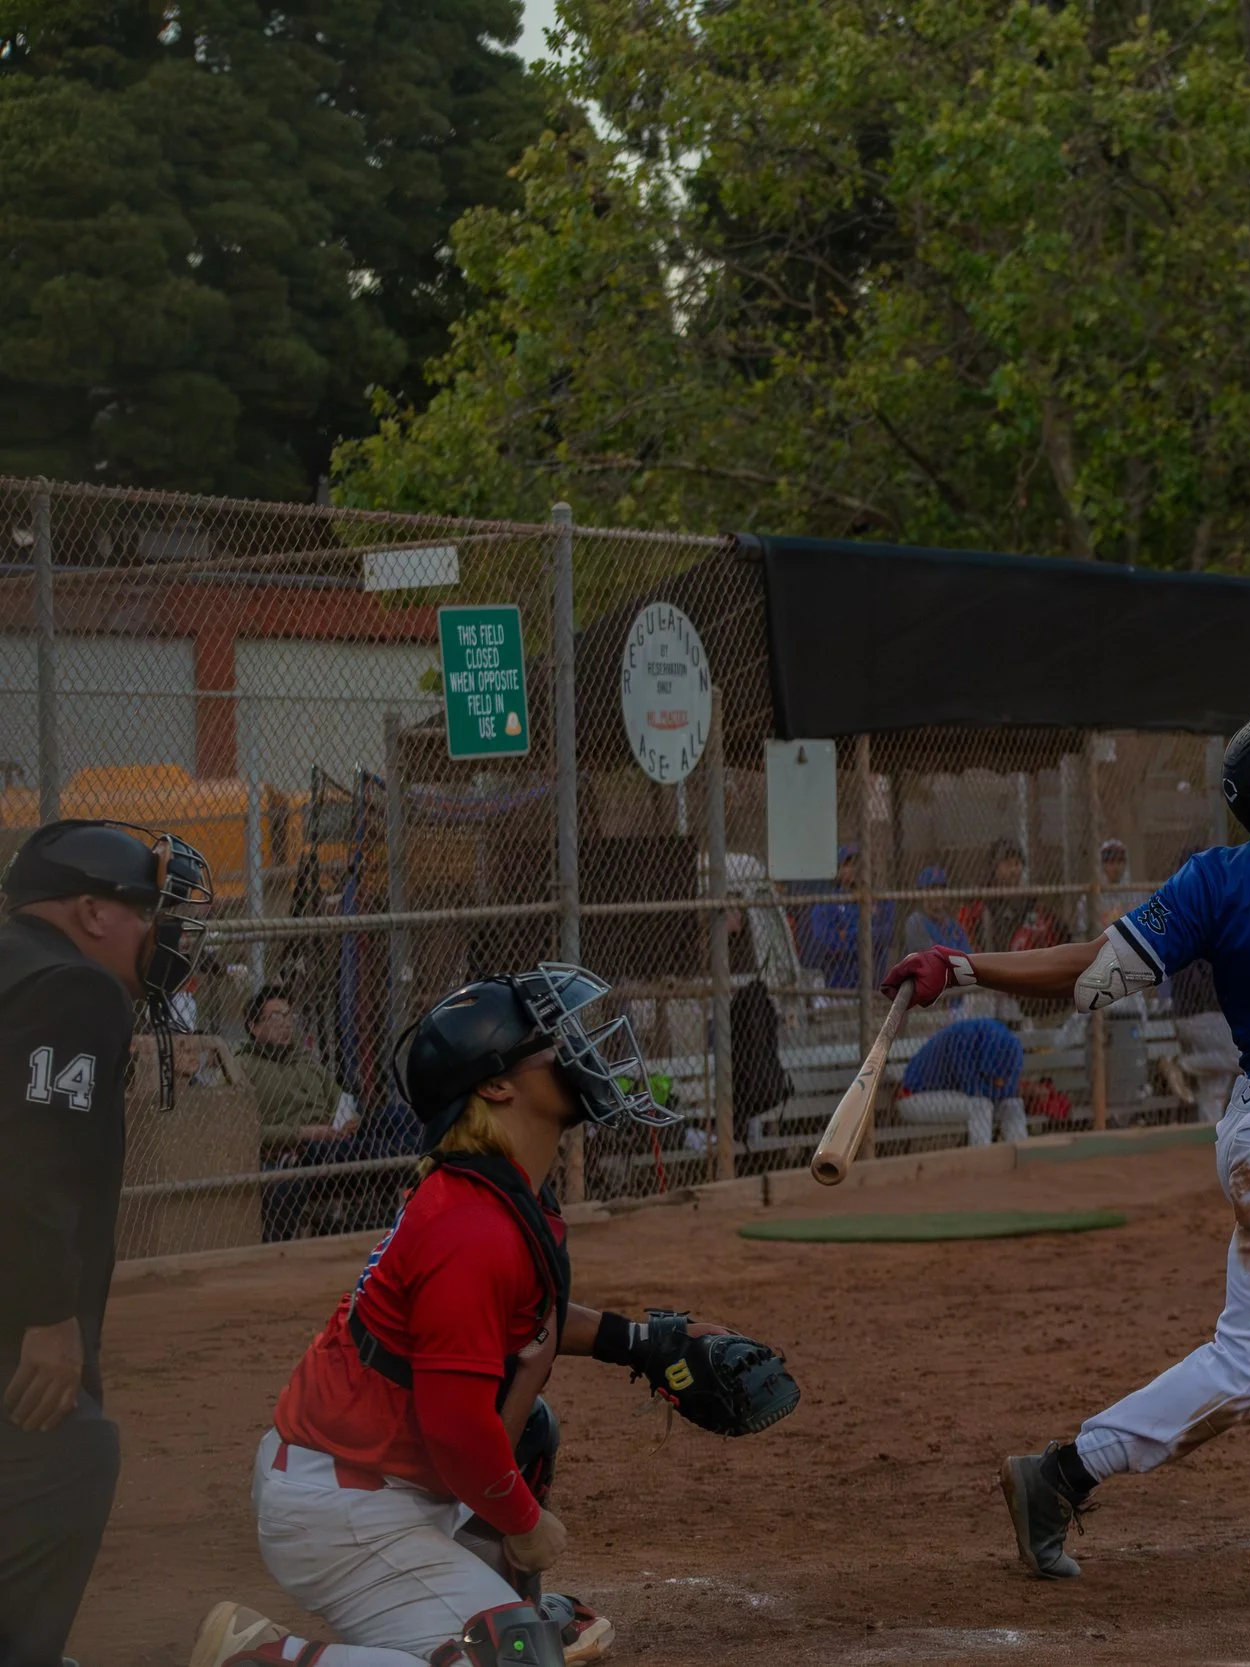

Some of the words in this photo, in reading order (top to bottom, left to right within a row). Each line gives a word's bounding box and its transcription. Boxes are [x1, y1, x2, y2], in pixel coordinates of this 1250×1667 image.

[457, 625, 477, 647] THIS
[479, 624, 505, 645] FIELD
[465, 648, 500, 669] CLOSED
[624, 607, 708, 694] REGULATION
[449, 671, 475, 692] WHEN
[478, 669, 520, 691] OPPOSITE
[467, 694, 492, 716] FIELD
[494, 693, 504, 713] IN
[478, 716, 497, 738] USE
[25, 1045, 96, 1112] 14
